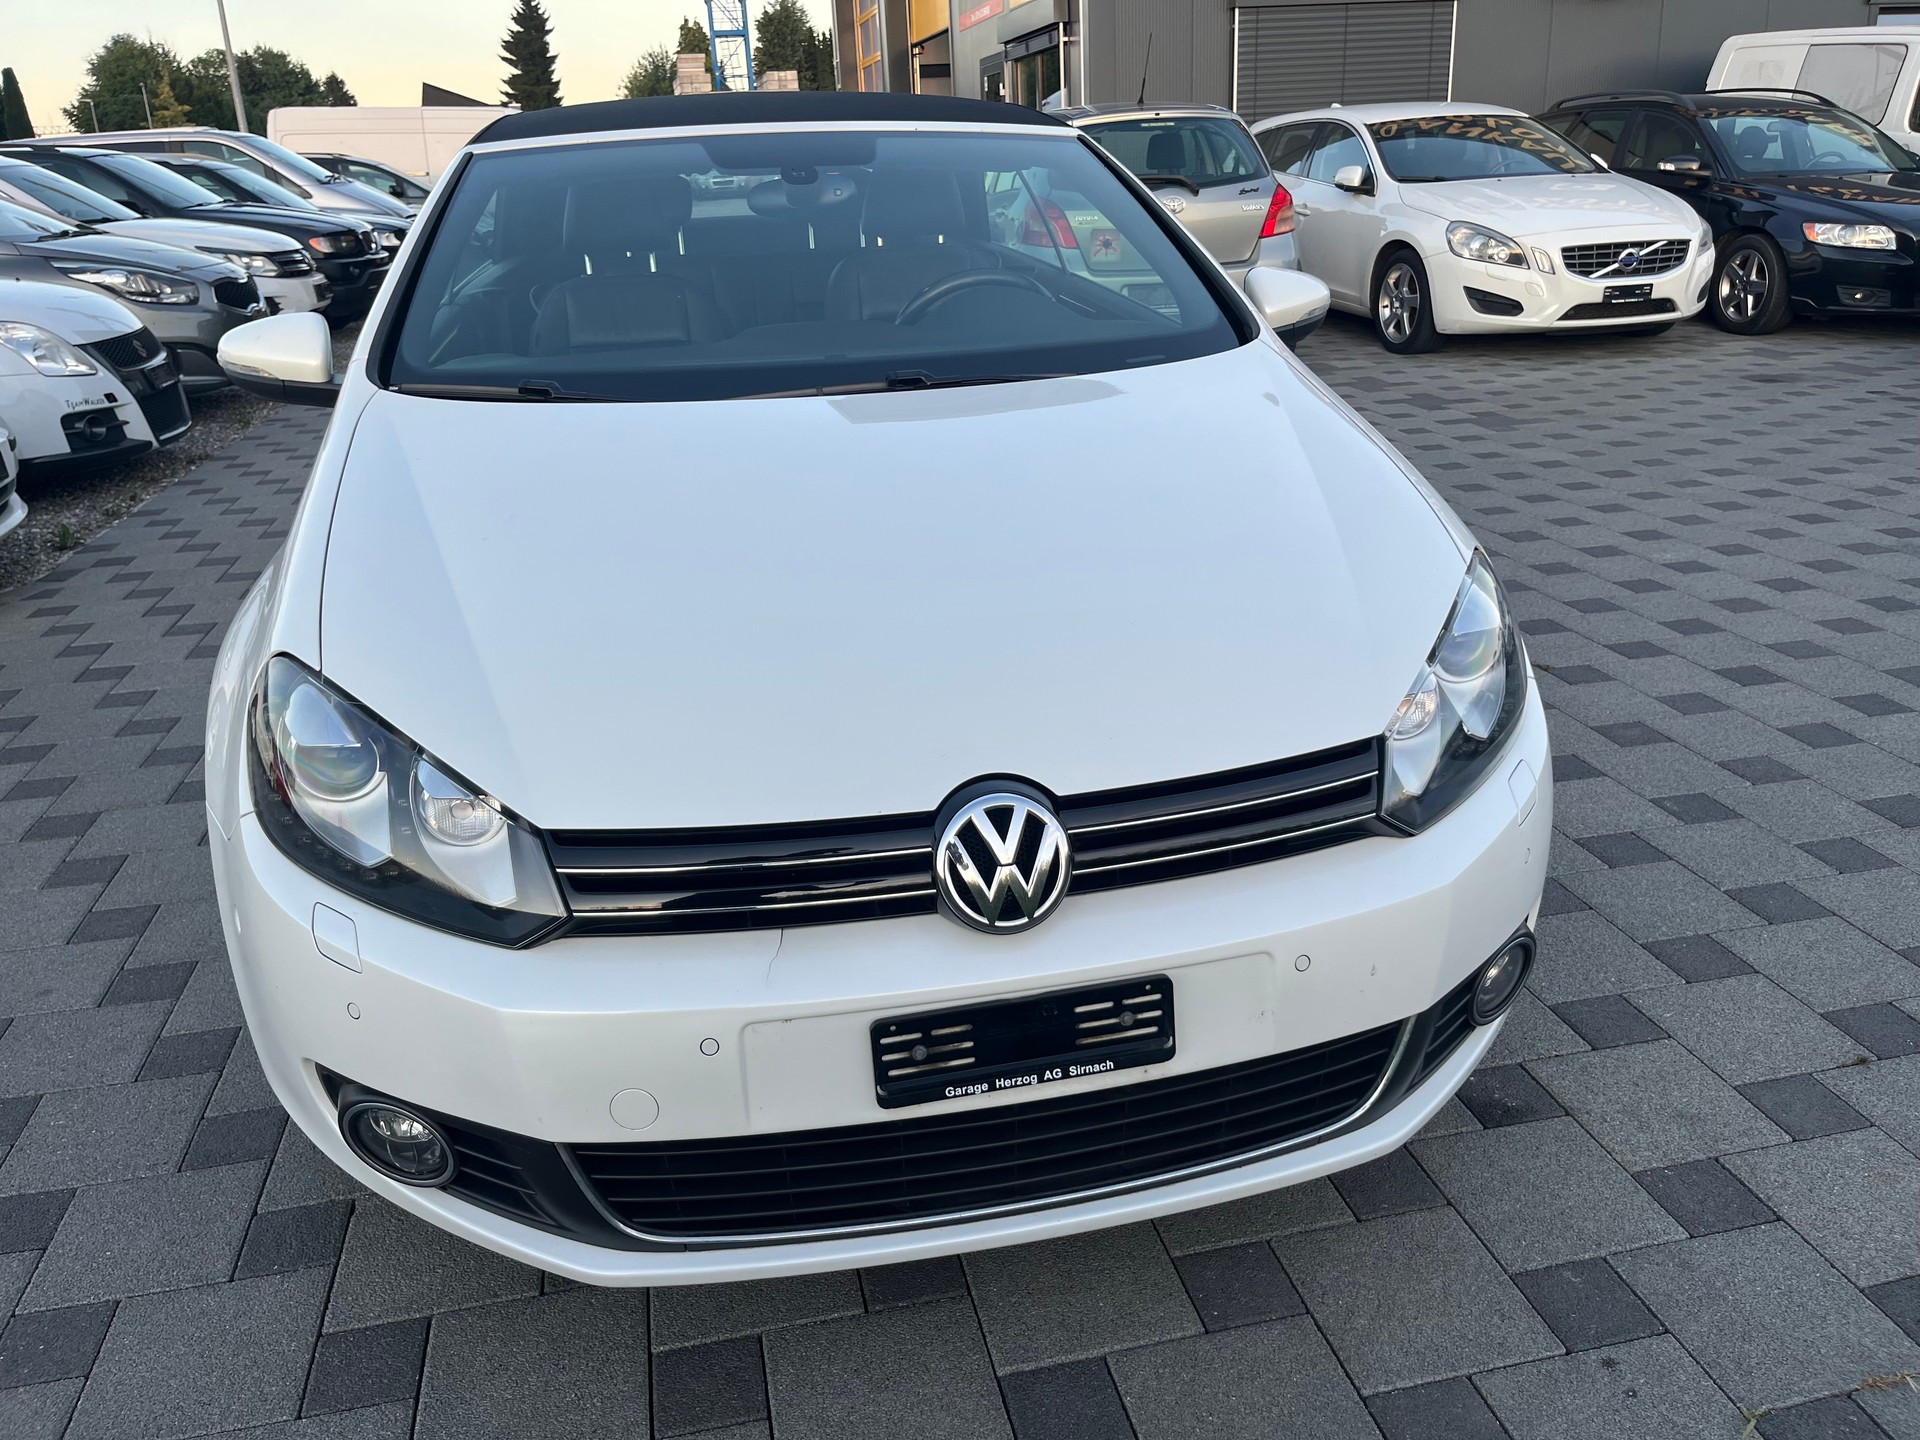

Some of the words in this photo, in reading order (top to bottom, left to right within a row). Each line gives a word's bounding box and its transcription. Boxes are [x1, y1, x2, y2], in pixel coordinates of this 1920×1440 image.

[945, 1082, 989, 1097] Garage
[995, 1073, 1038, 1089] Herzog
[1043, 1068, 1062, 1081] AG
[1069, 1060, 1114, 1076] Sirnach
